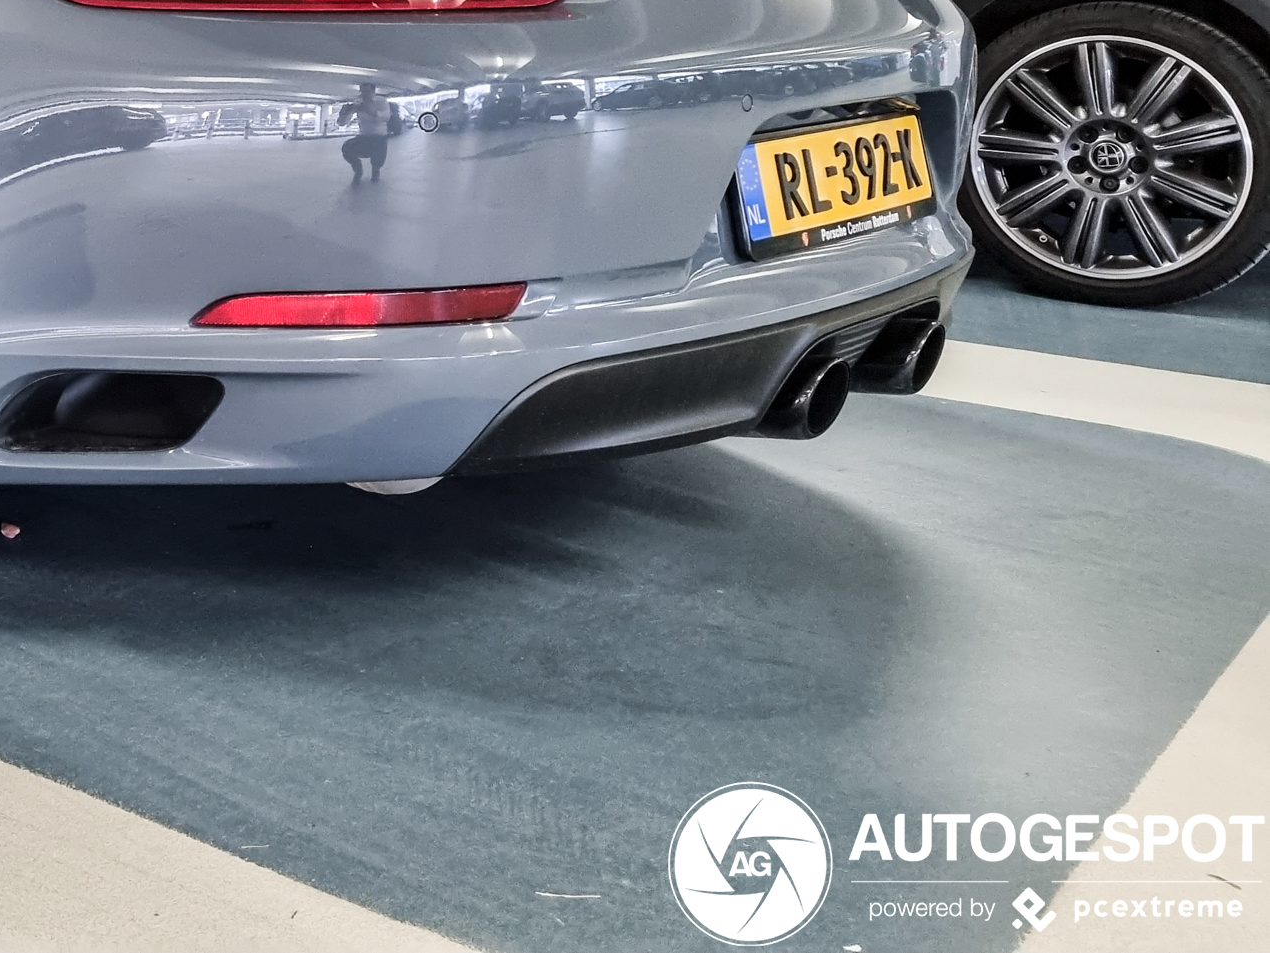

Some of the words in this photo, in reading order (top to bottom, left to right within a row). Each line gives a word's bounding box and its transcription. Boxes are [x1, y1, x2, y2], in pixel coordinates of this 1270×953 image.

[773, 128, 923, 220] RL-392-K
[746, 204, 766, 226] NL
[820, 225, 847, 242] Porsche
[847, 220, 873, 235] Centrum
[872, 211, 900, 229] Rotterdam
